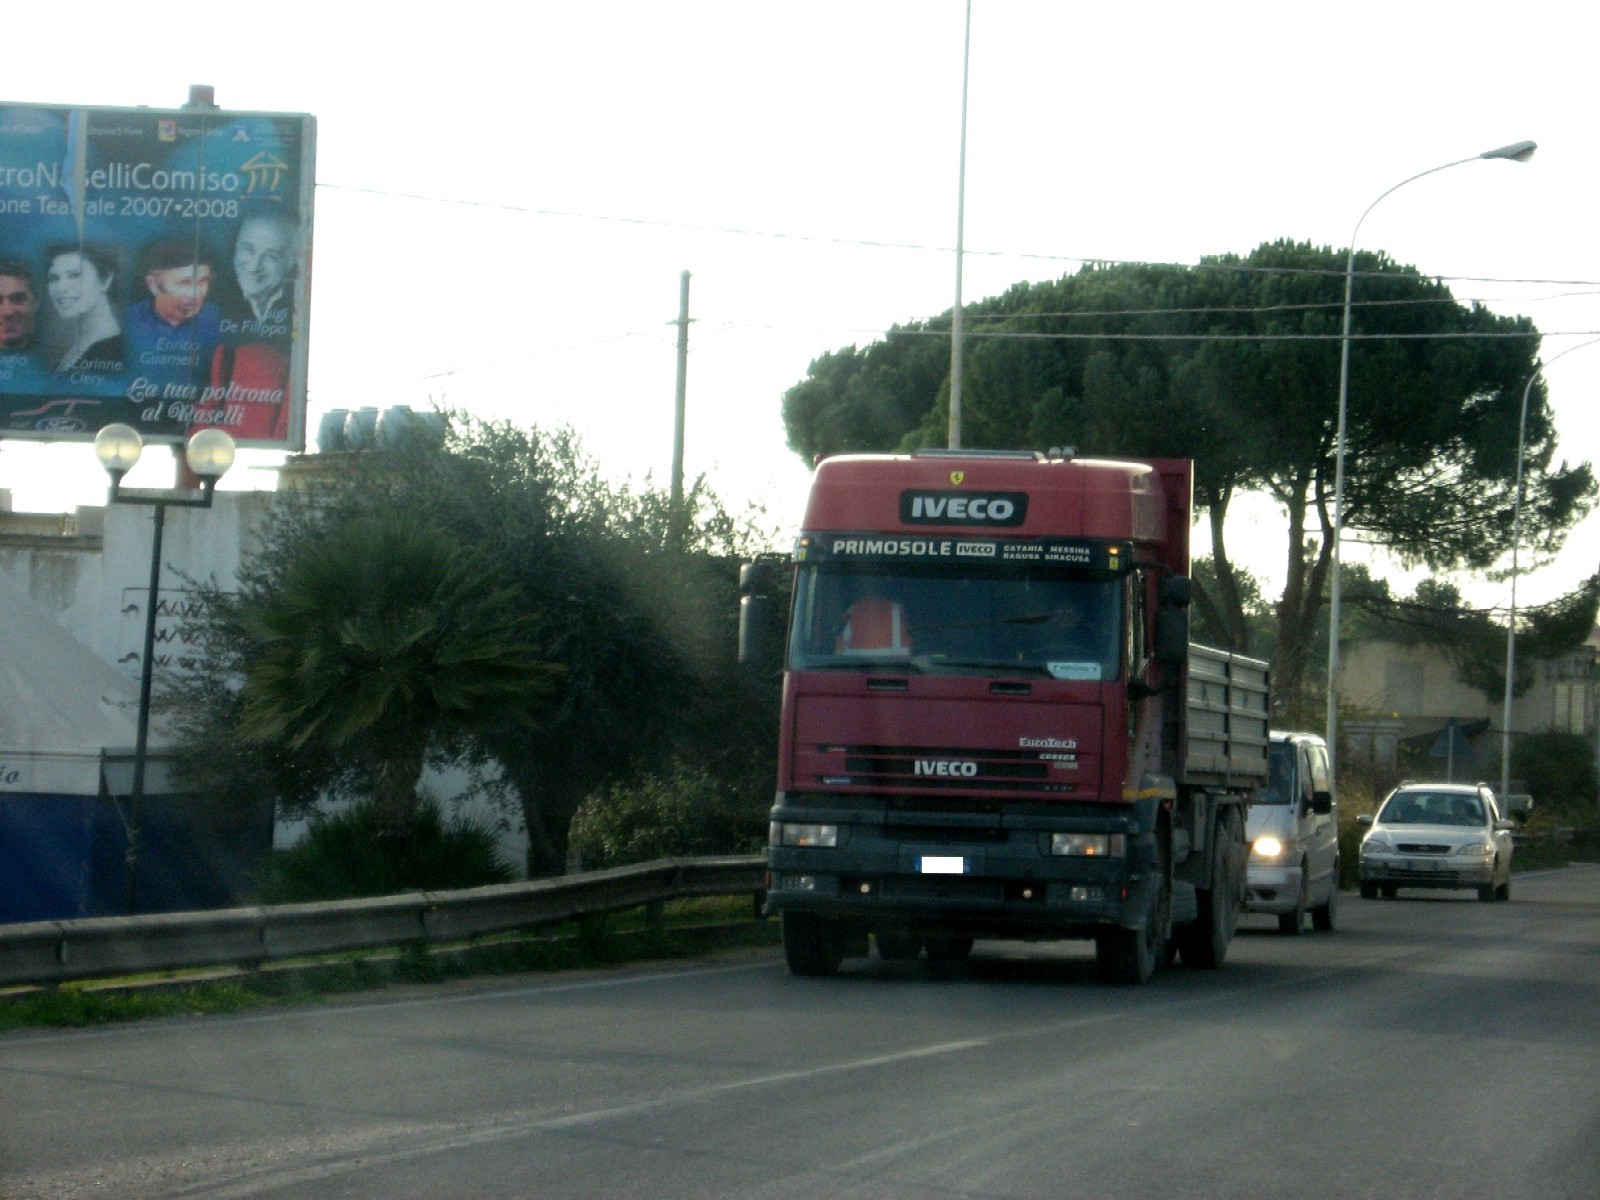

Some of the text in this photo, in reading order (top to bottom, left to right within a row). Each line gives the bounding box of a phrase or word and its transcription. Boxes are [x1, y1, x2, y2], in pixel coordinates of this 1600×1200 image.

[220, 320, 238, 333] De
[127, 377, 285, 404] La tua poltrona
[142, 401, 245, 426] al Naselli
[911, 496, 1015, 519] IVECO
[833, 541, 995, 556] PRIMOSOLE IVECO
[1050, 546, 1090, 554] MESSINA
[1045, 554, 1090, 563] SIRACUSA
[1019, 737, 1077, 748] EuroTech
[914, 760, 977, 777] IVECO
